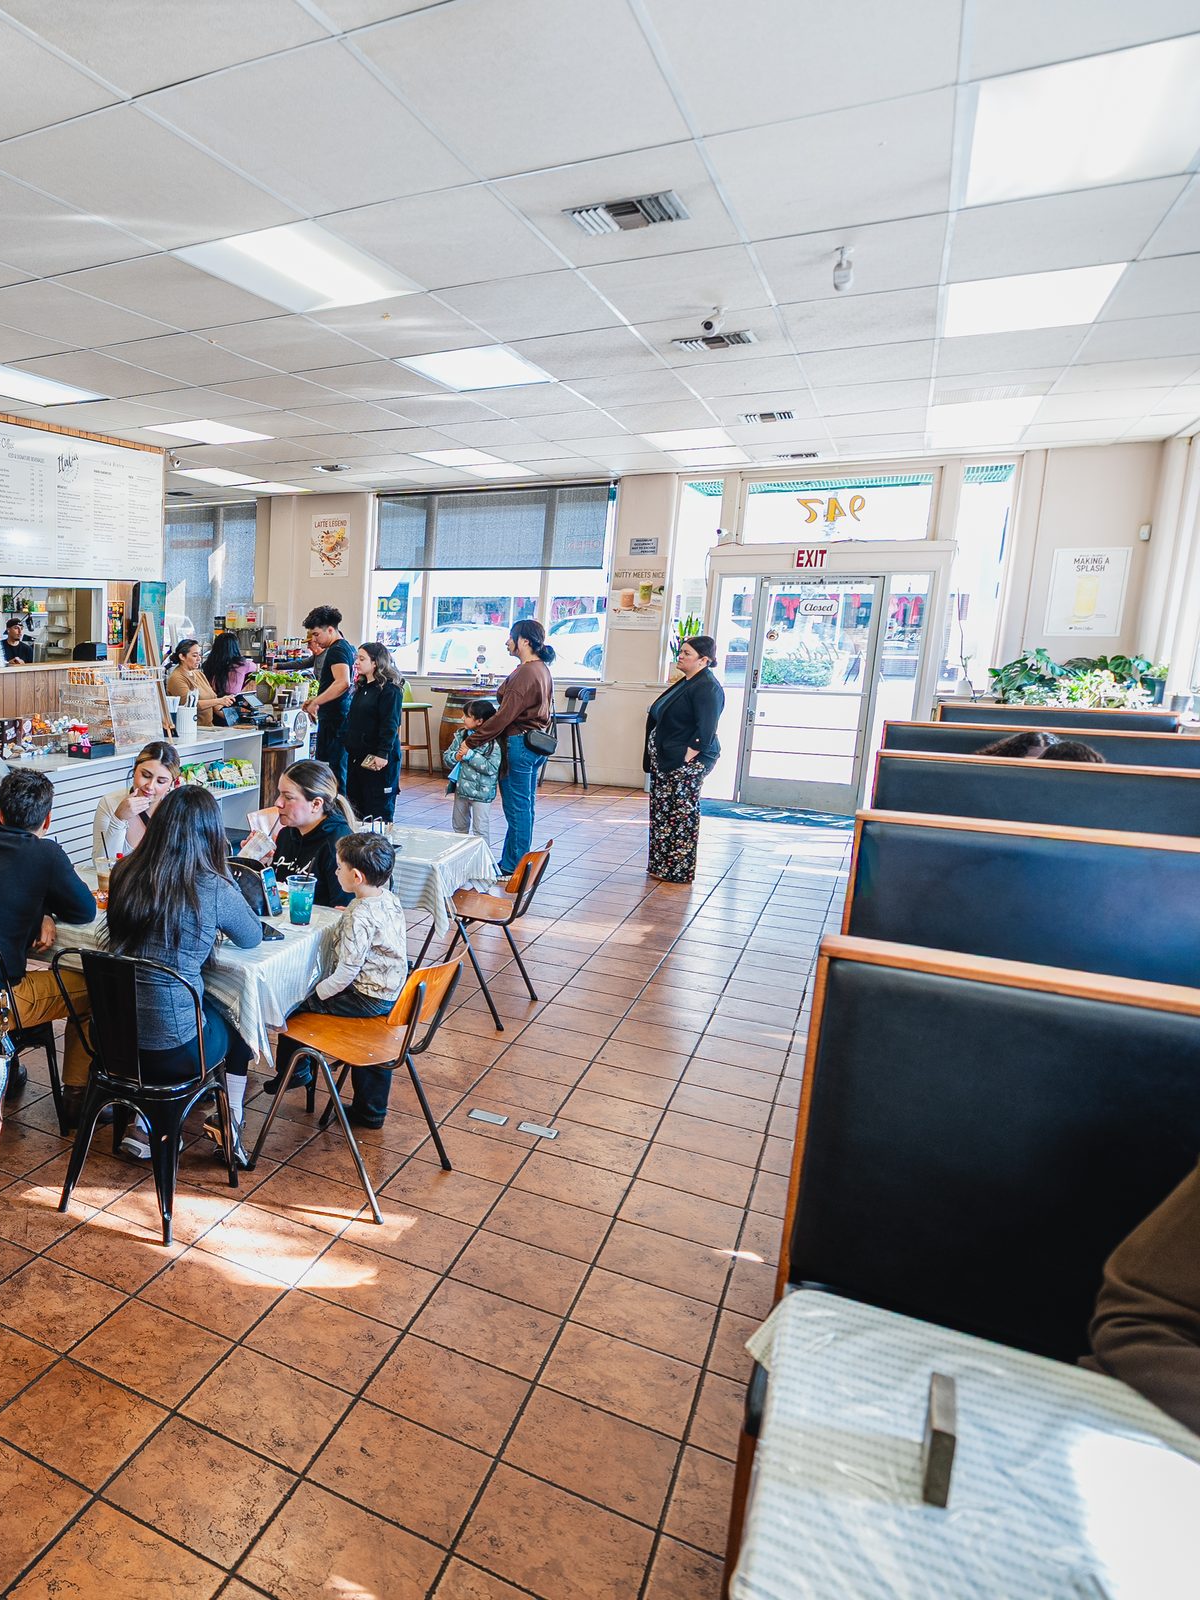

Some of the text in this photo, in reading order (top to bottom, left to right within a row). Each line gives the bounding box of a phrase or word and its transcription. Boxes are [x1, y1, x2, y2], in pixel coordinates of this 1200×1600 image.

[314, 519, 347, 528] LATTE LEGEND
[796, 549, 827, 568] EXIT
[1073, 556, 1110, 565] MAKING A
[1076, 564, 1105, 572] SPLASH
[614, 571, 631, 579] NUTTY
[632, 571, 651, 579] MEETS
[803, 602, 834, 612] Closed
